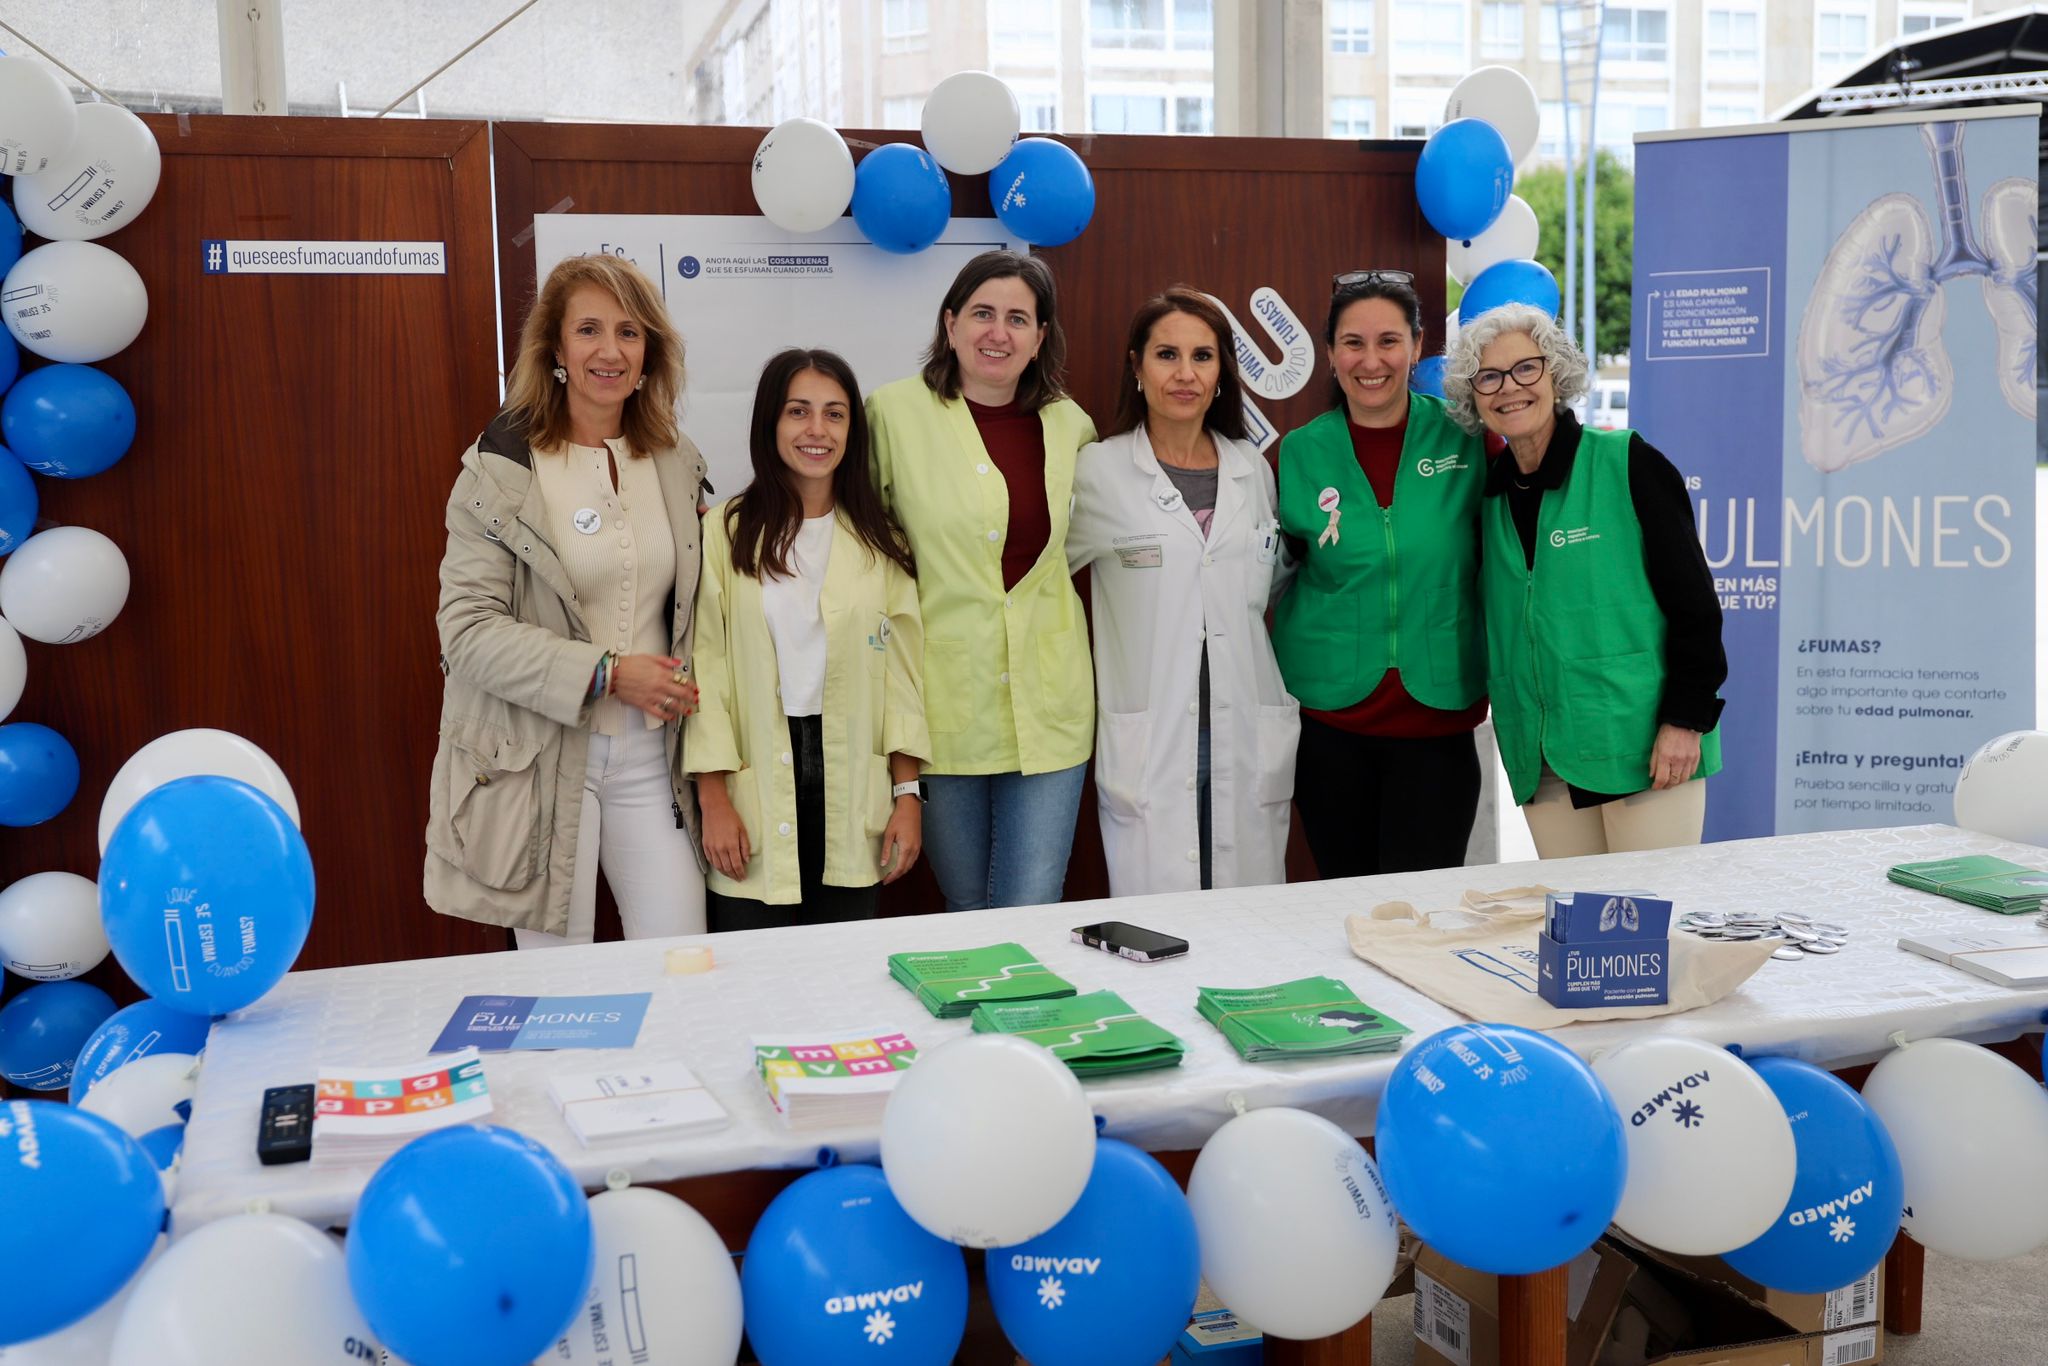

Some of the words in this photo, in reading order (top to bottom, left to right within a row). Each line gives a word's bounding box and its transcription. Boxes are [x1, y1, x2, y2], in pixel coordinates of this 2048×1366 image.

[102, 178, 115, 189] SE
[80, 188, 106, 210] ESFUMA
[101, 200, 126, 222] FUMAS?
[705, 257, 731, 265] ANOTA
[732, 256, 752, 266] AQUÍ
[753, 257, 767, 265] LAS
[770, 257, 794, 265] COSAS
[796, 257, 828, 265] BUENAS
[705, 266, 722, 274] QUE
[1663, 290, 1675, 298] LA
[1676, 289, 1699, 298] EDAD
[1700, 287, 1748, 297] PULMONAR
[1663, 300, 1674, 308] ES
[1675, 299, 1694, 307] UNA
[1695, 297, 1736, 307] CAMPAÑA
[1255, 294, 1299, 346] FUMAS?
[1663, 310, 1674, 318] DE
[1663, 319, 1690, 327] SOBRE
[1692, 319, 1702, 327] EL
[1704, 316, 1759, 326] TABAQUISMO
[1663, 329, 1669, 337] Y
[1670, 329, 1681, 337] EL
[1682, 328, 1729, 337] DETERIORO
[1730, 327, 1741, 335] DE
[1742, 326, 1755, 334] LA
[1662, 338, 1699, 347] FUNCIÓN
[1700, 337, 1747, 346] PULMONAR
[1264, 346, 1306, 393] CUANDO
[1699, 494, 2012, 569] ULMONES
[1714, 577, 1737, 592] EN
[1740, 574, 1776, 592] MÁS
[1719, 595, 1740, 609] UE
[1743, 592, 1776, 609] TÚ?
[1797, 639, 1882, 654] ¿FUMAS?
[1796, 666, 1813, 678] En
[1816, 667, 1846, 678] esta
[1849, 667, 1914, 680] farmacia
[1917, 668, 1980, 681] tenemos
[1796, 686, 1828, 699] algo
[1831, 686, 1908, 700] importante
[1912, 689, 1941, 702] que
[1944, 689, 2007, 701] contarte
[1796, 704, 1834, 716] sobre
[1837, 705, 1851, 715] tu
[1855, 705, 1894, 717] edad
[1898, 706, 1974, 719] pulmonar.
[1795, 750, 1848, 767] ¡Entra
[1855, 754, 1868, 769] y
[1871, 753, 1965, 771] pregunta!
[1794, 778, 1845, 790] Prueba
[1848, 778, 1900, 791] sencilla
[1903, 783, 1913, 795] y
[1915, 782, 1956, 796] gratu
[1794, 799, 1818, 810] por
[1821, 797, 1871, 812] tiempo
[1874, 798, 1936, 813] limitado.
[195, 903, 212, 919] SE
[198, 923, 217, 963] ESFUMA
[239, 916, 257, 954] FUMAS?
[206, 956, 255, 978] CUANDO
[1566, 953, 1661, 980] PULMONES
[469, 1012, 622, 1026] PULMONES
[1446, 1040, 1481, 1067] ESFUMA
[1413, 1064, 1446, 1095] FUMAS?
[1473, 1063, 1493, 1080] SE
[1630, 1069, 1711, 1127] ADAMED
[1342, 1175, 1371, 1220] FUMAS?
[1788, 1180, 1873, 1227] ADAMED
[1010, 1254, 1102, 1275] ADAMED
[825, 1280, 923, 1314] ADAMED
[589, 1302, 610, 1353] ESFUMA
